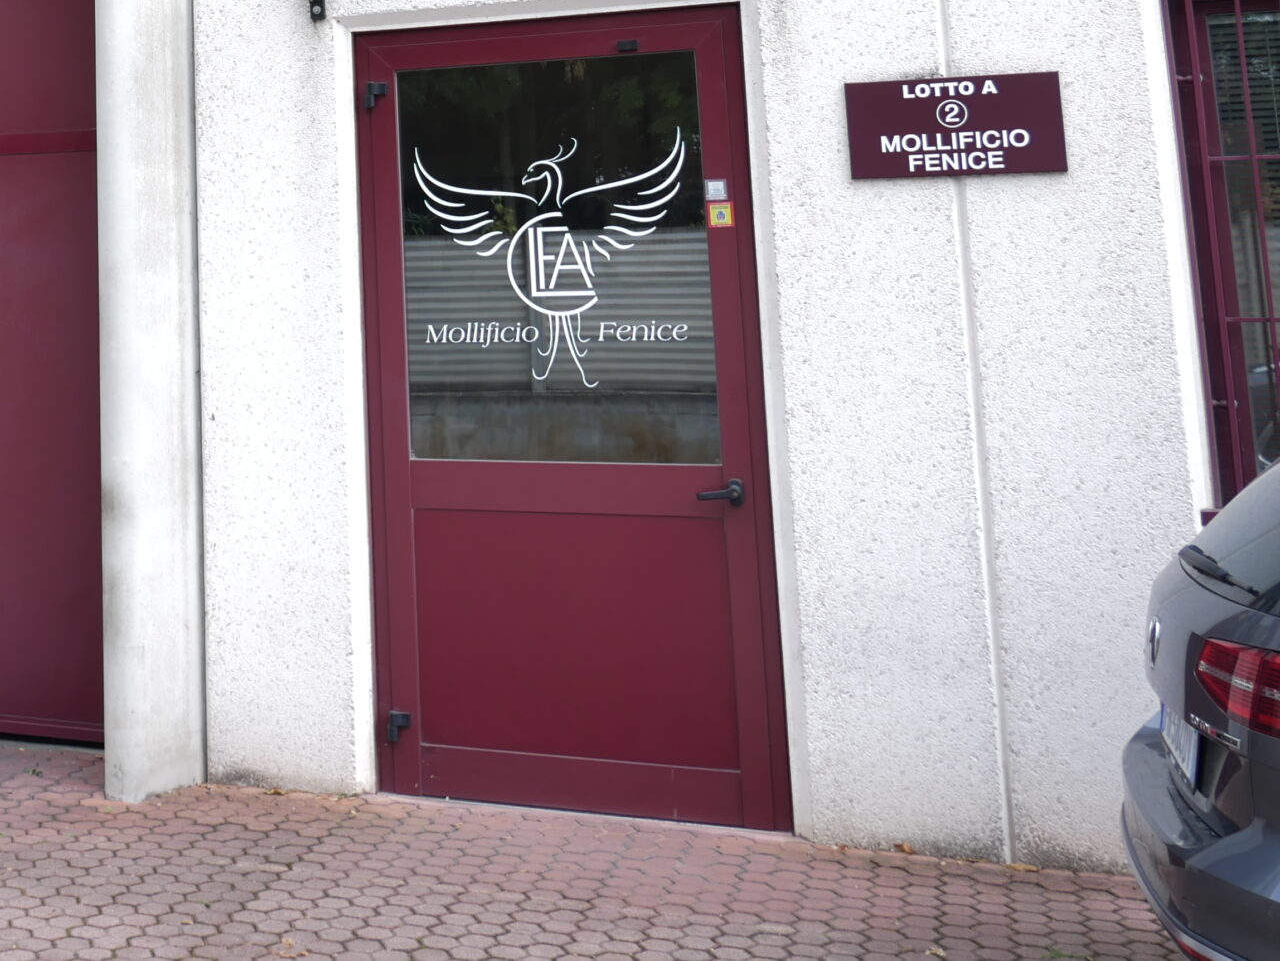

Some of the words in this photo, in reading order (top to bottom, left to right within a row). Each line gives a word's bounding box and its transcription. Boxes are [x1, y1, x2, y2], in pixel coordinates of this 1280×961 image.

[902, 81, 975, 99] LOTTO
[981, 80, 998, 94] A
[944, 103, 960, 123] 2
[880, 128, 1030, 153] MOLLIFICIO
[908, 150, 1005, 172] FENICE
[425, 322, 540, 348] Mollificio
[598, 320, 688, 342] Fenice
